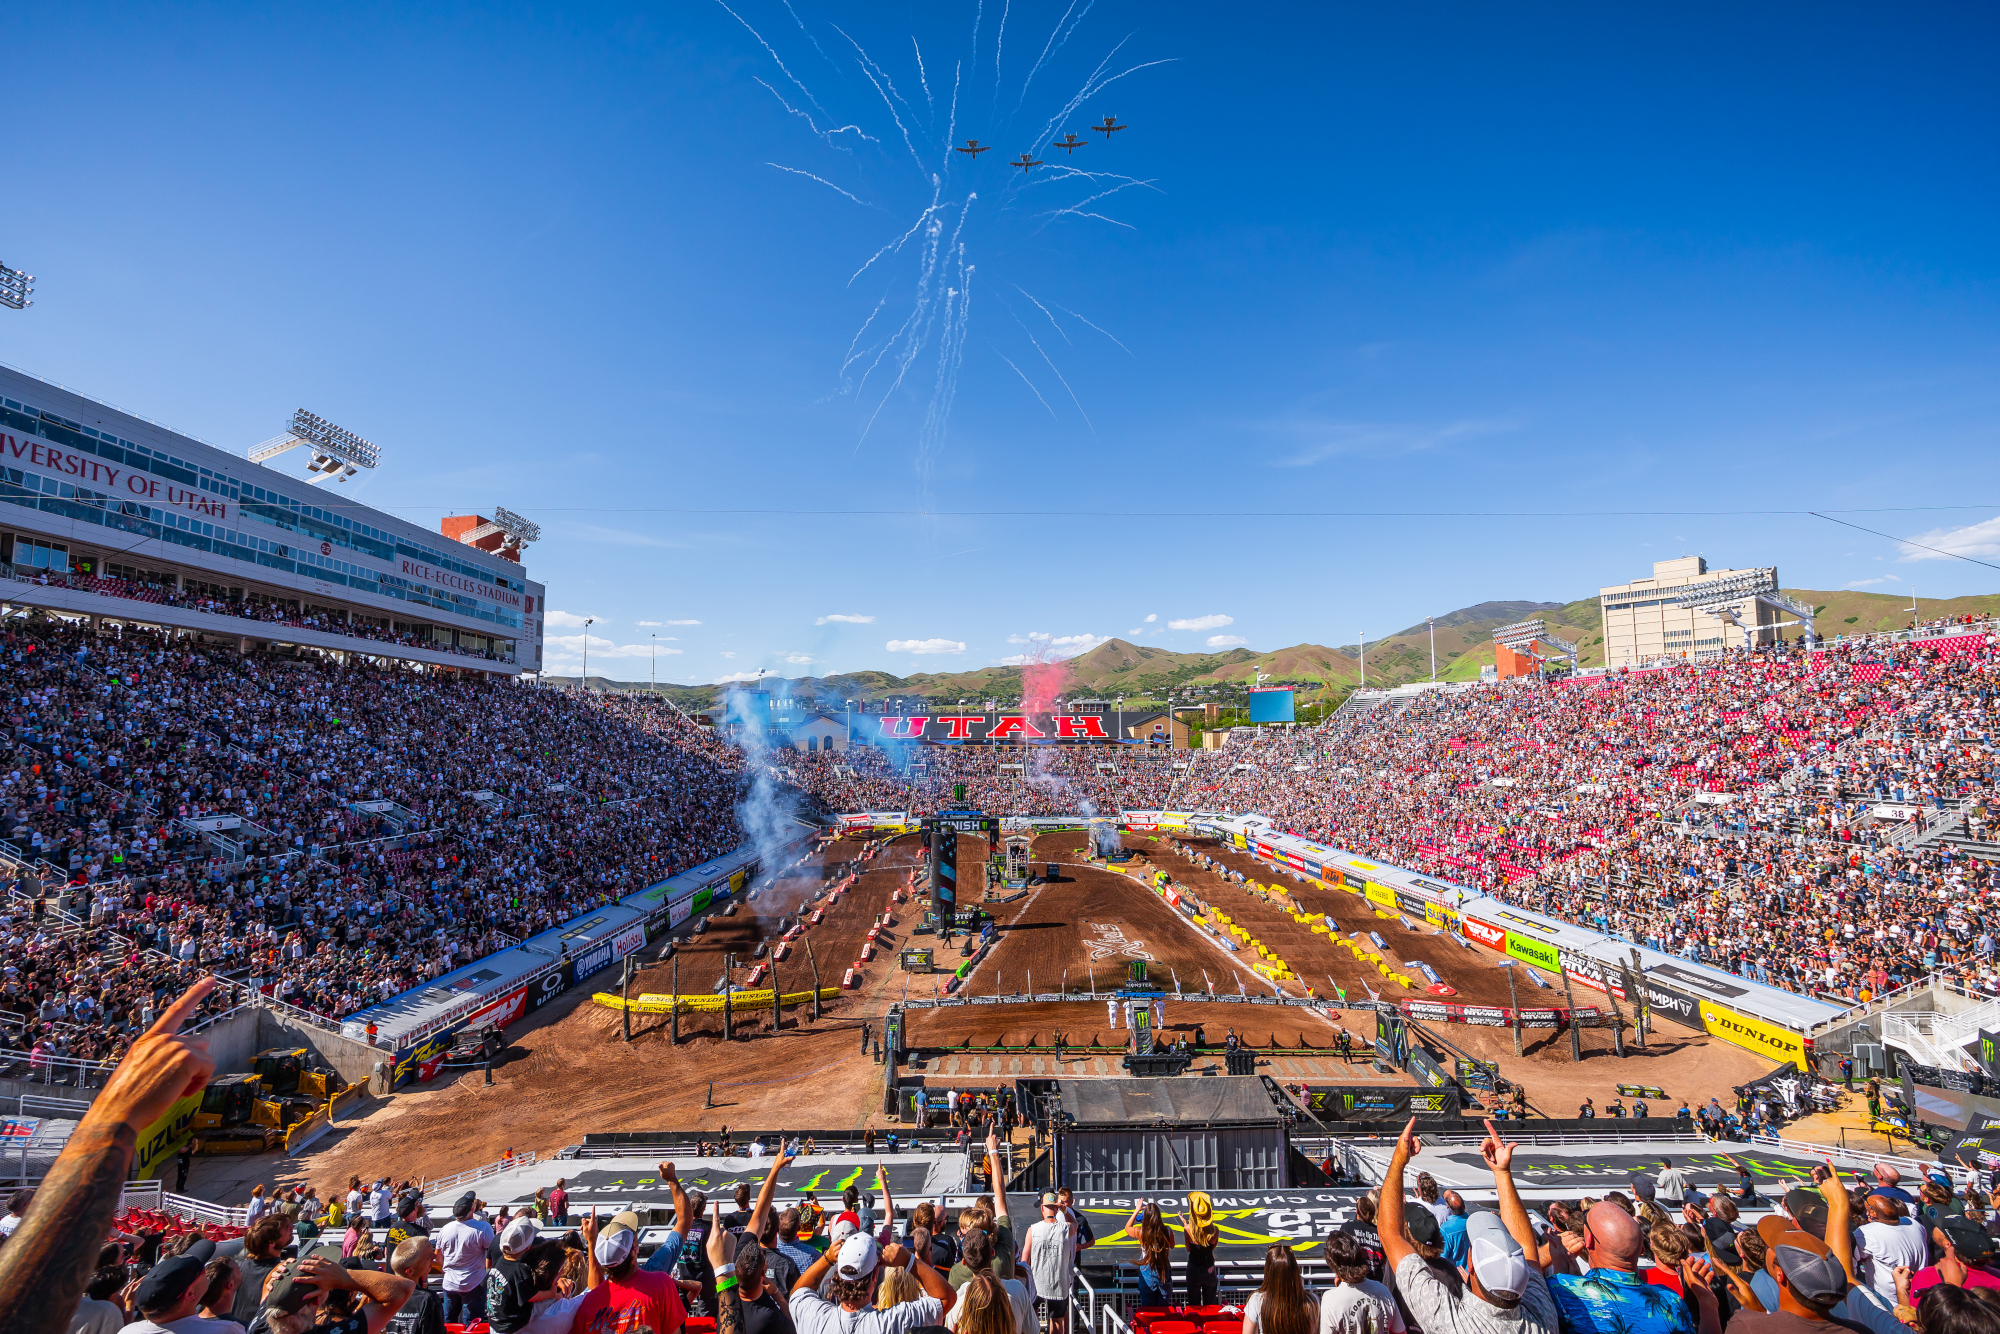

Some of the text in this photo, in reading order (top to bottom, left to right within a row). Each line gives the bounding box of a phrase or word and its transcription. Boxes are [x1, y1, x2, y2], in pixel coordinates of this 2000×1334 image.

[128, 475, 161, 498] OF
[168, 486, 226, 519] UTAH
[402, 560, 520, 606] RICE-ECCLES STADIUM
[879, 716, 1109, 738] UTAH
[1707, 795, 1716, 803] 37
[216, 820, 222, 828] 9
[1891, 809, 1905, 818] 38
[1325, 870, 1340, 883] KTM
[1413, 901, 1425, 910] SPORTS
[617, 933, 643, 957] Holiday
[1510, 938, 1553, 965] Kawasaki
[584, 944, 611, 971] YAMAHA
[537, 983, 565, 1007] OAKLEY
[735, 992, 773, 1000] DUNLOP
[1719, 1027, 1793, 1059] MOTORCYCLE TIRES
[1720, 1018, 1798, 1053] DUNLOP
